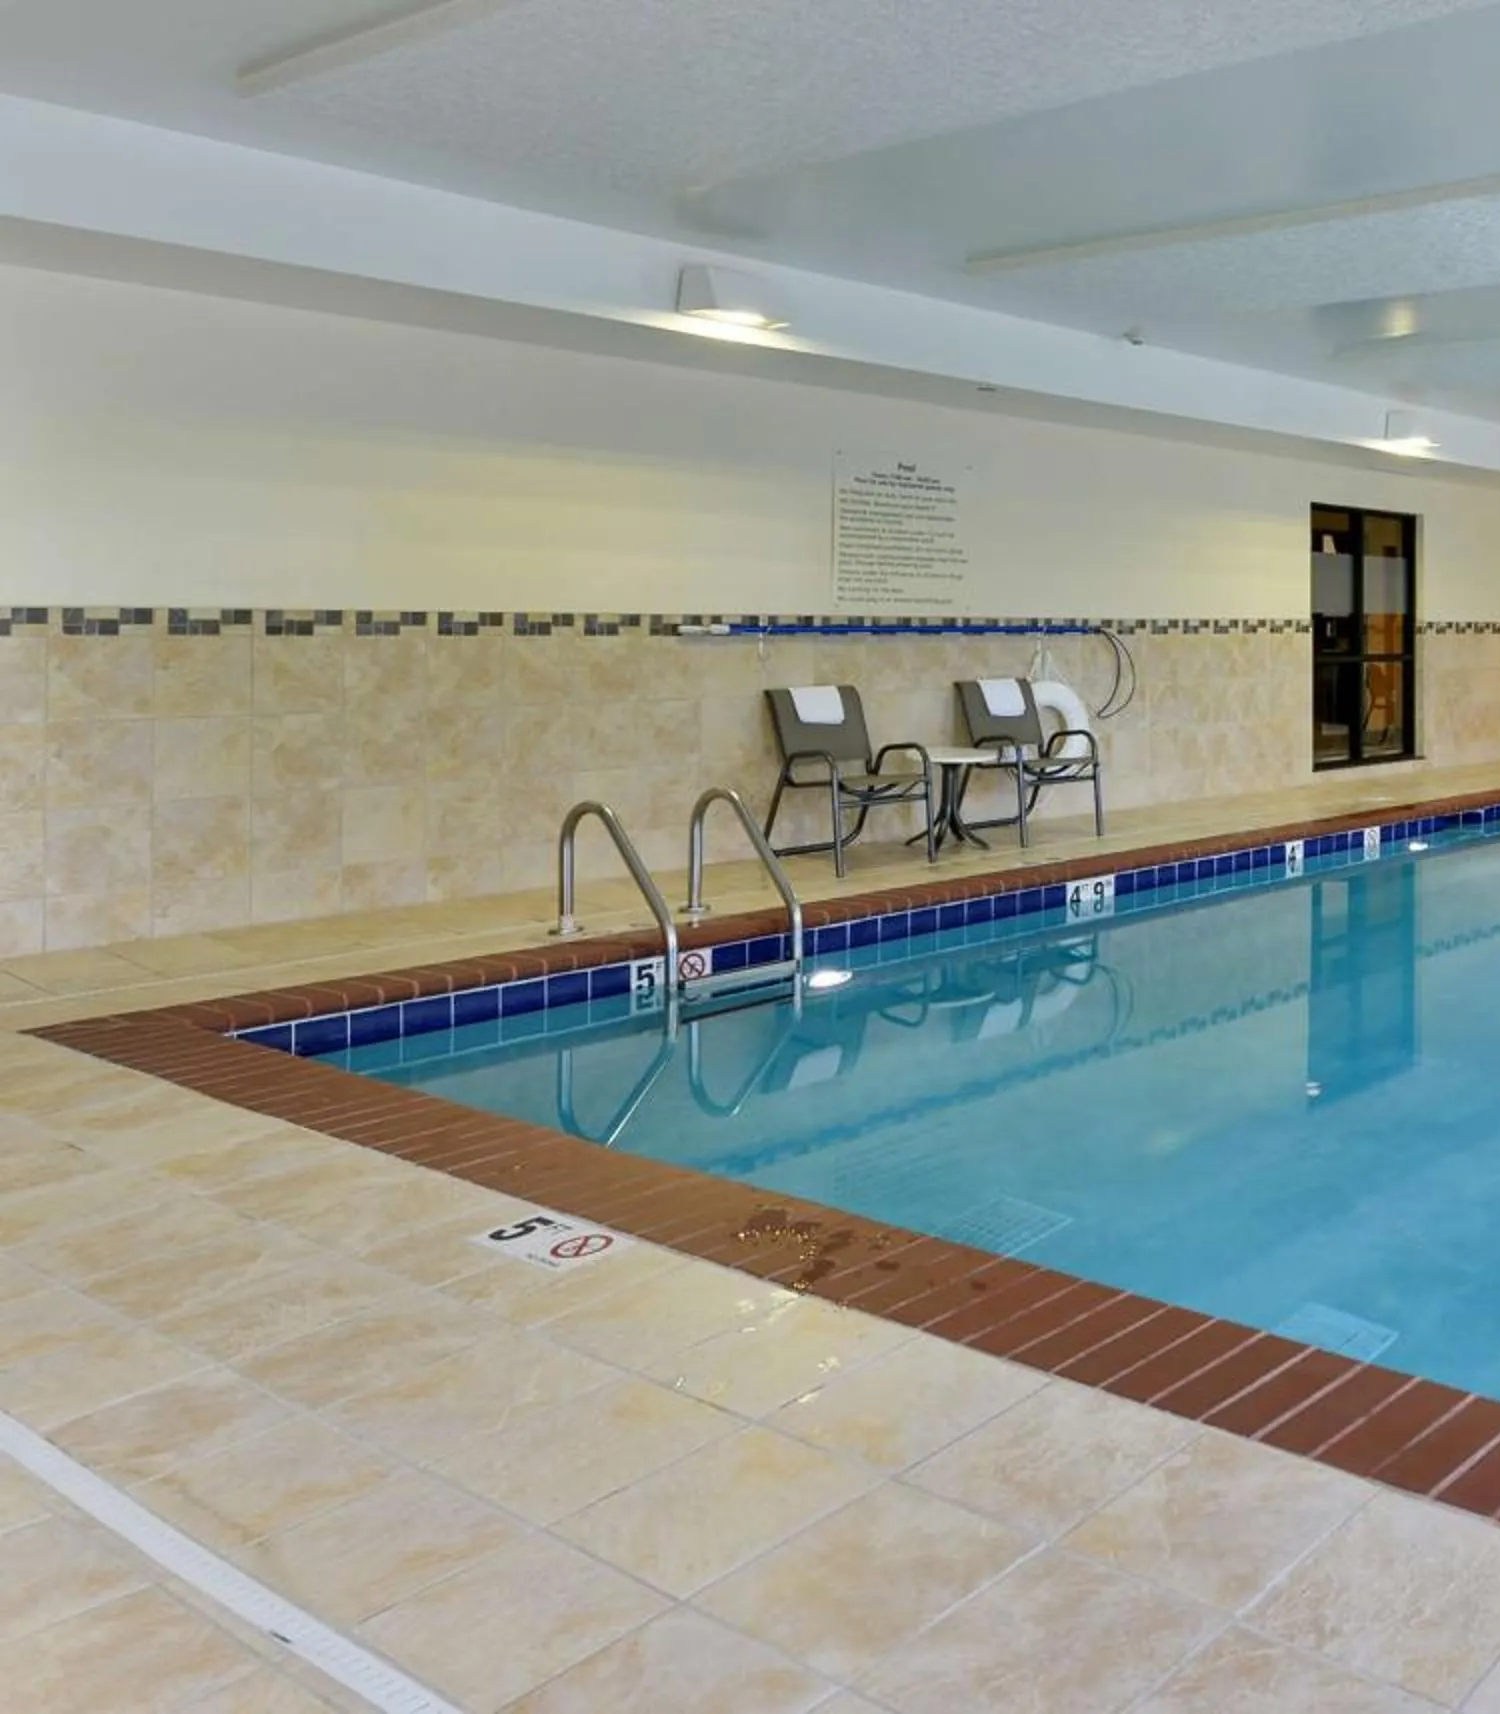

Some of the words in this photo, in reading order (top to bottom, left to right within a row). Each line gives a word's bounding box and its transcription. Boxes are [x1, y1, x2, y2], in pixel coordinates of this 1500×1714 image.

[897, 462, 916, 473] Pool
[1070, 885, 1081, 903] 4
[1093, 881, 1105, 897] 9
[636, 963, 655, 990] 5
[488, 1215, 555, 1241] 5
